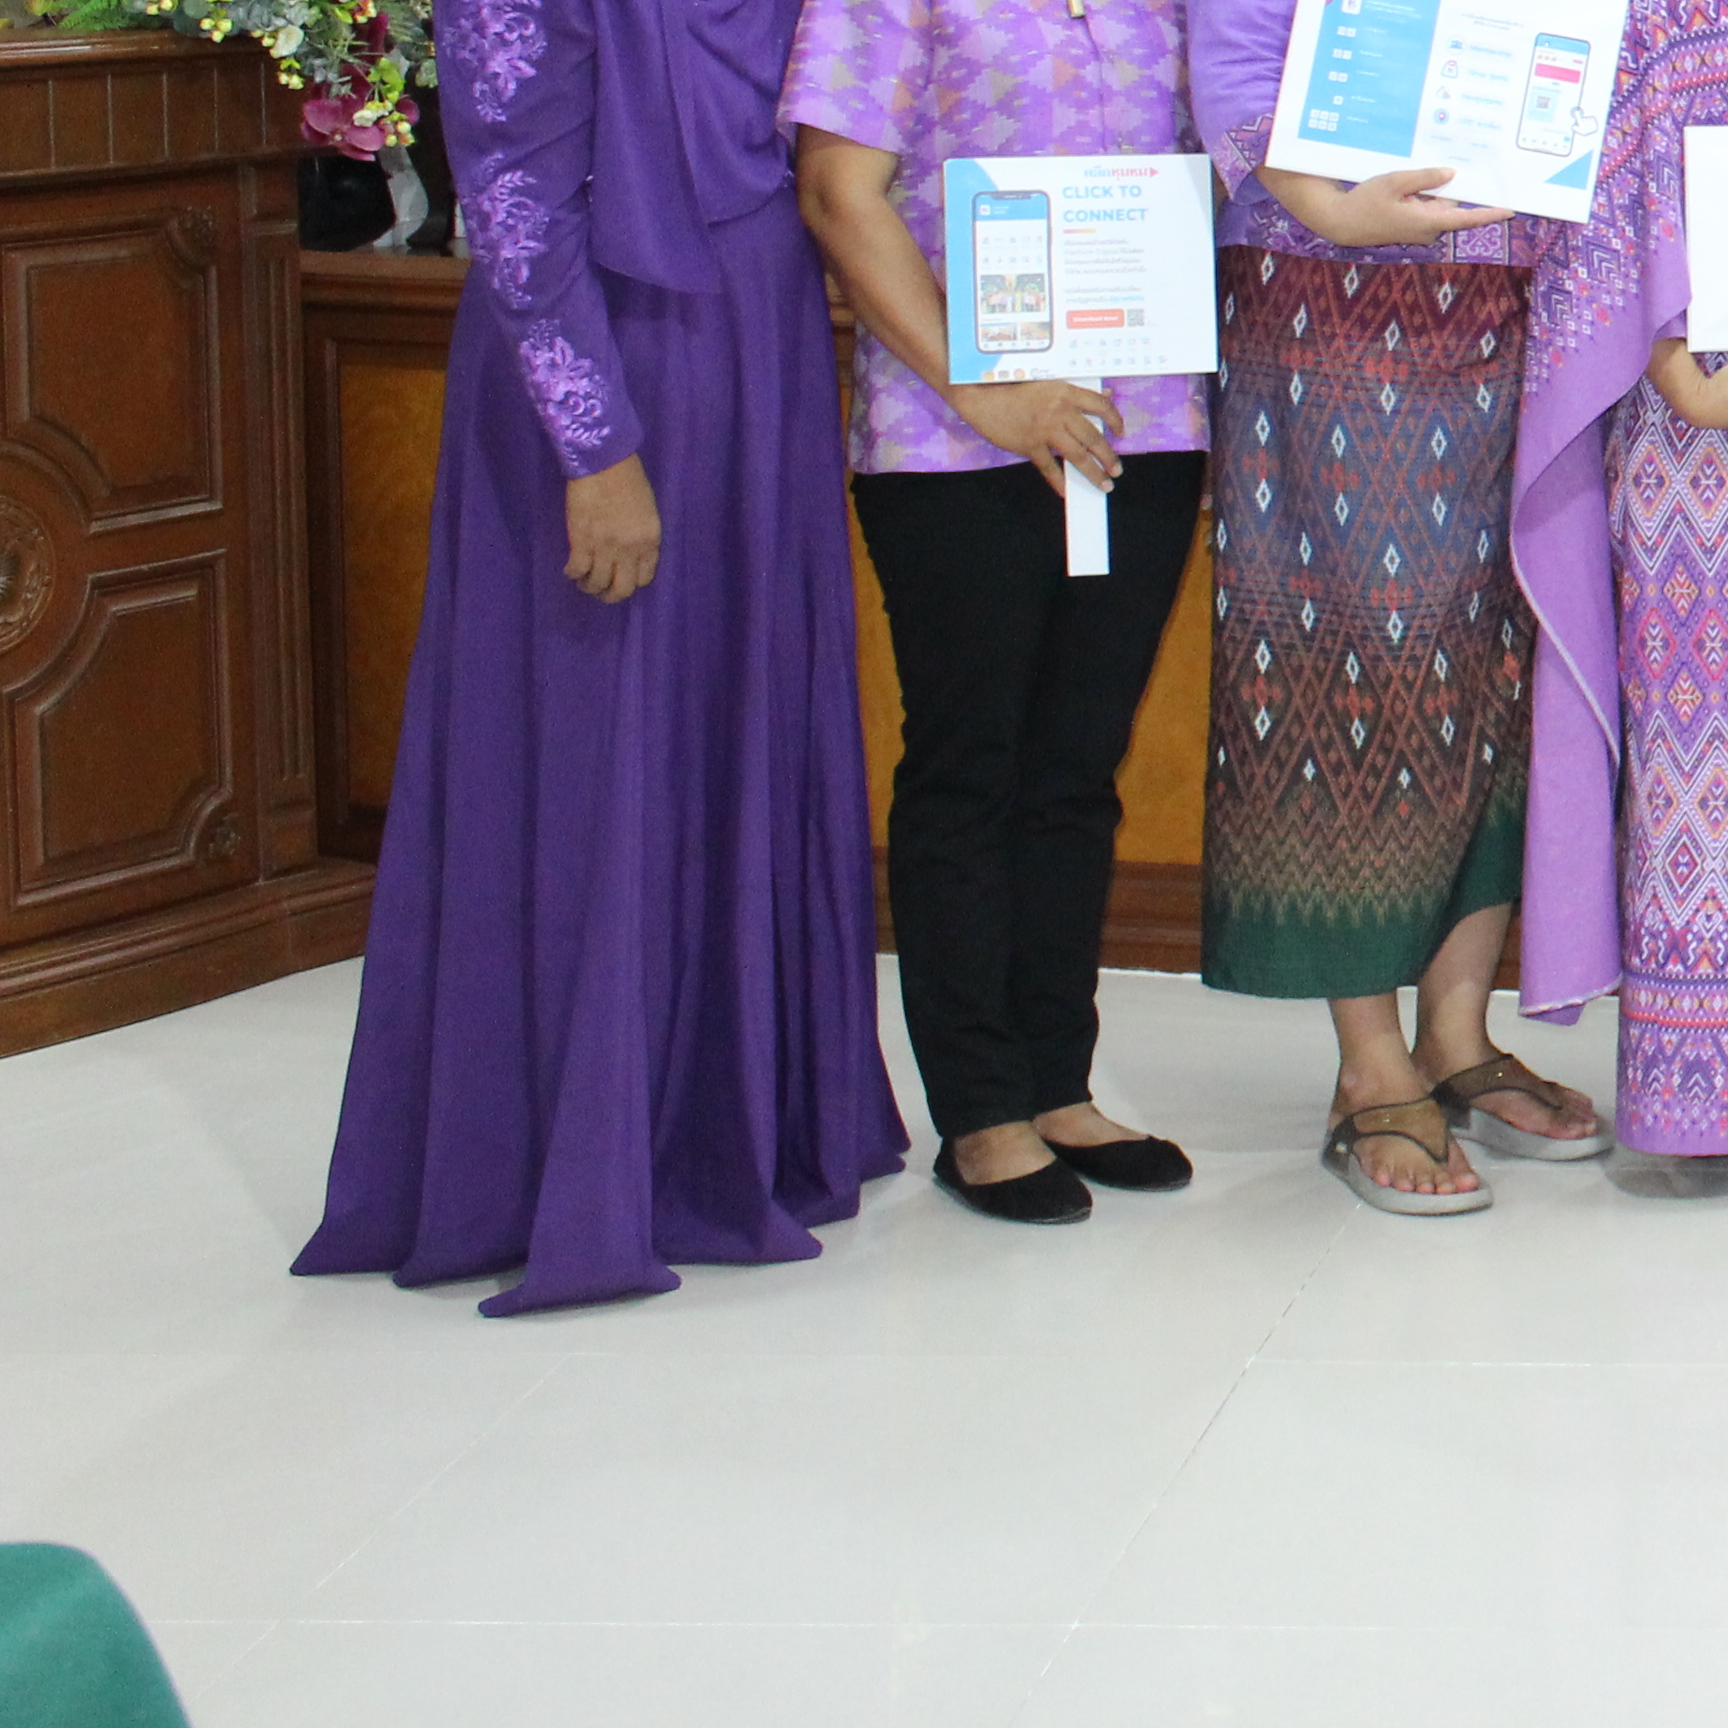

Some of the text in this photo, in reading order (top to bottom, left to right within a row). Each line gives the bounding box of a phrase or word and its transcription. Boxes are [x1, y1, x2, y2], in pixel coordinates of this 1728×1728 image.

[1062, 184, 1142, 200] CLICK TO
[1062, 207, 1148, 223] CONNECT
